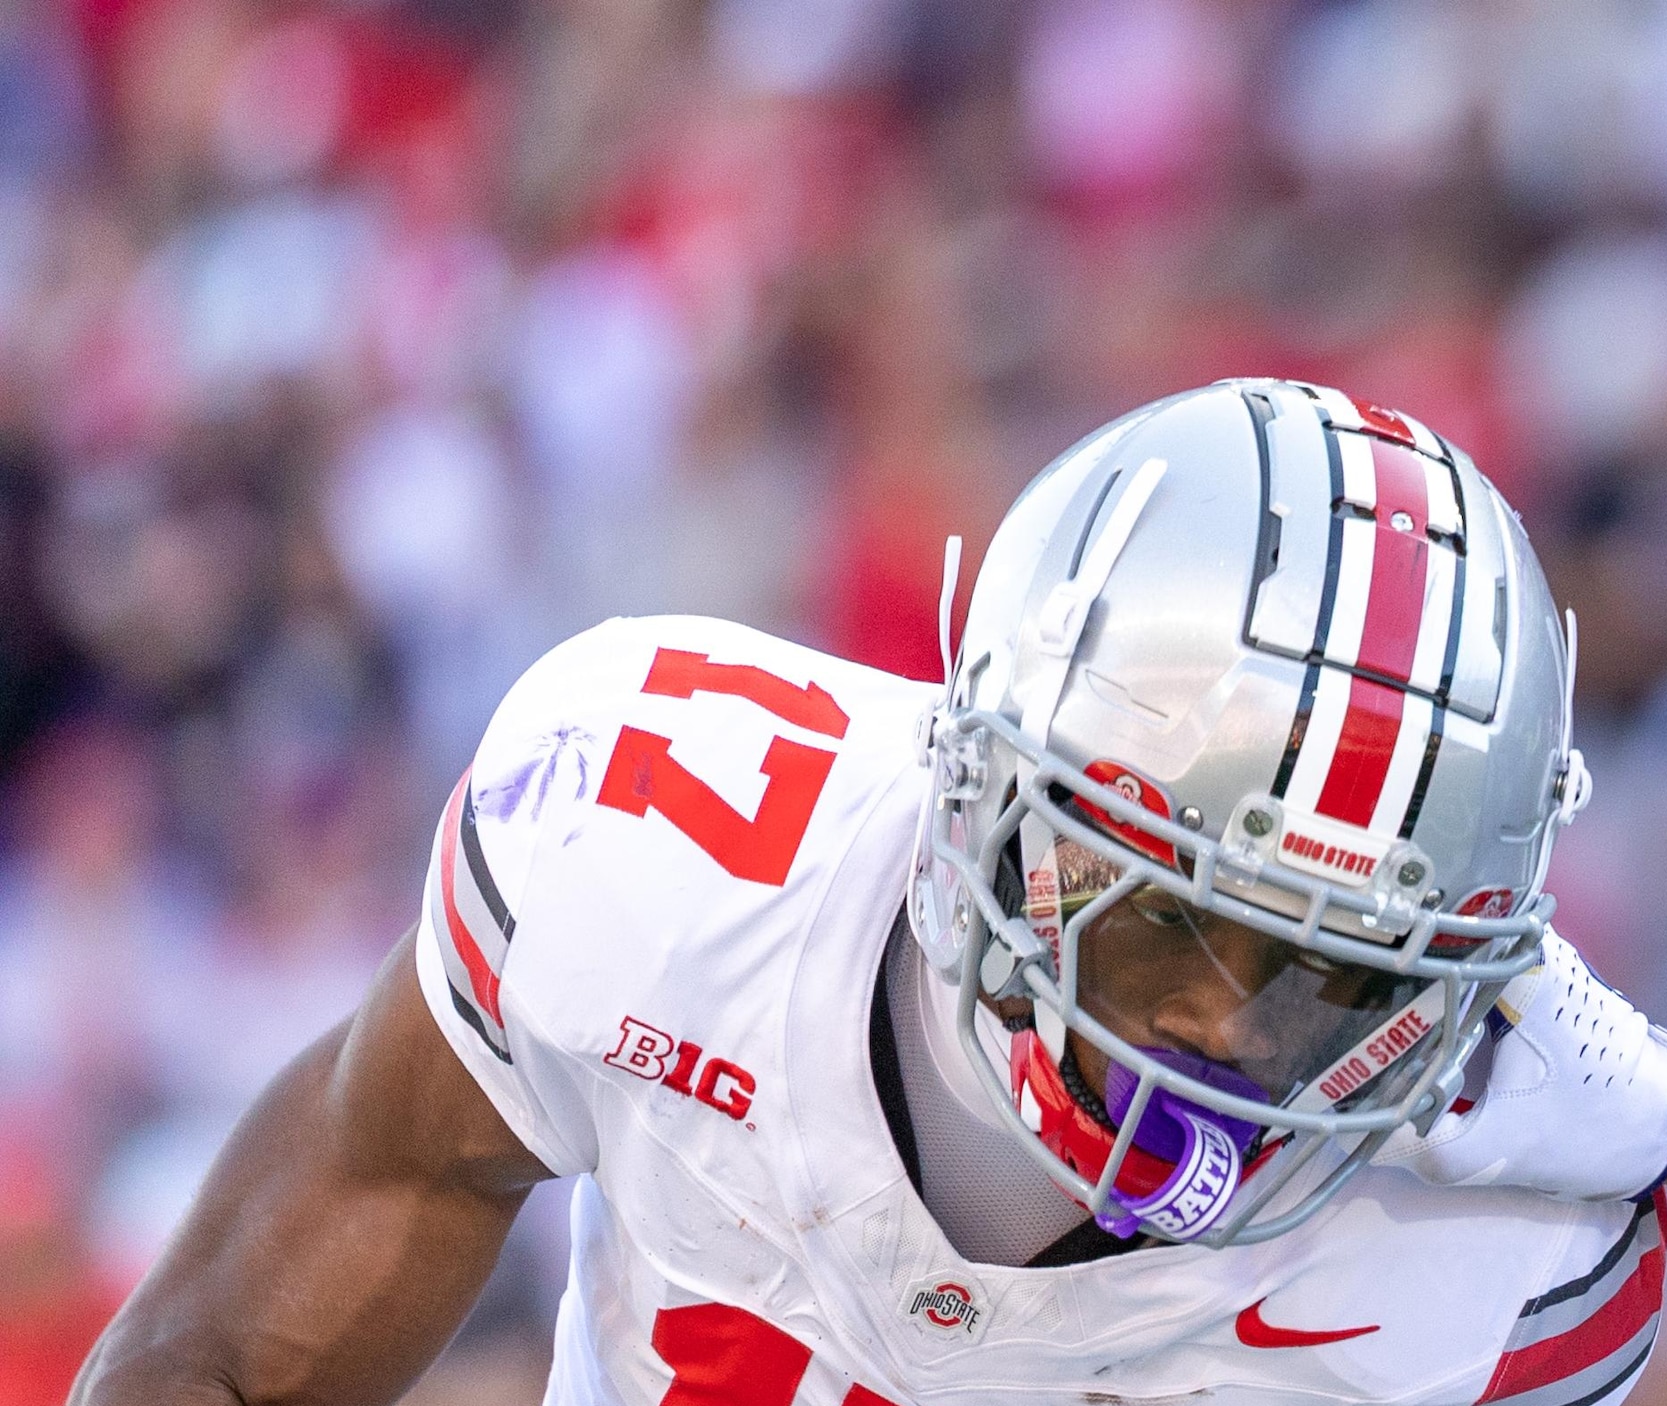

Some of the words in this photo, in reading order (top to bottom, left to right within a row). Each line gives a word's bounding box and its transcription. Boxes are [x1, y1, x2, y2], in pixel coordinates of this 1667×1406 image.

[596, 646, 850, 887] 17
[1282, 831, 1325, 861] OHIO
[1324, 846, 1377, 877] STATE
[1319, 1056, 1372, 1100] OHIO
[1365, 1009, 1430, 1066] STATE
[909, 1291, 946, 1315] OHIO
[940, 1293, 981, 1334] STATE
